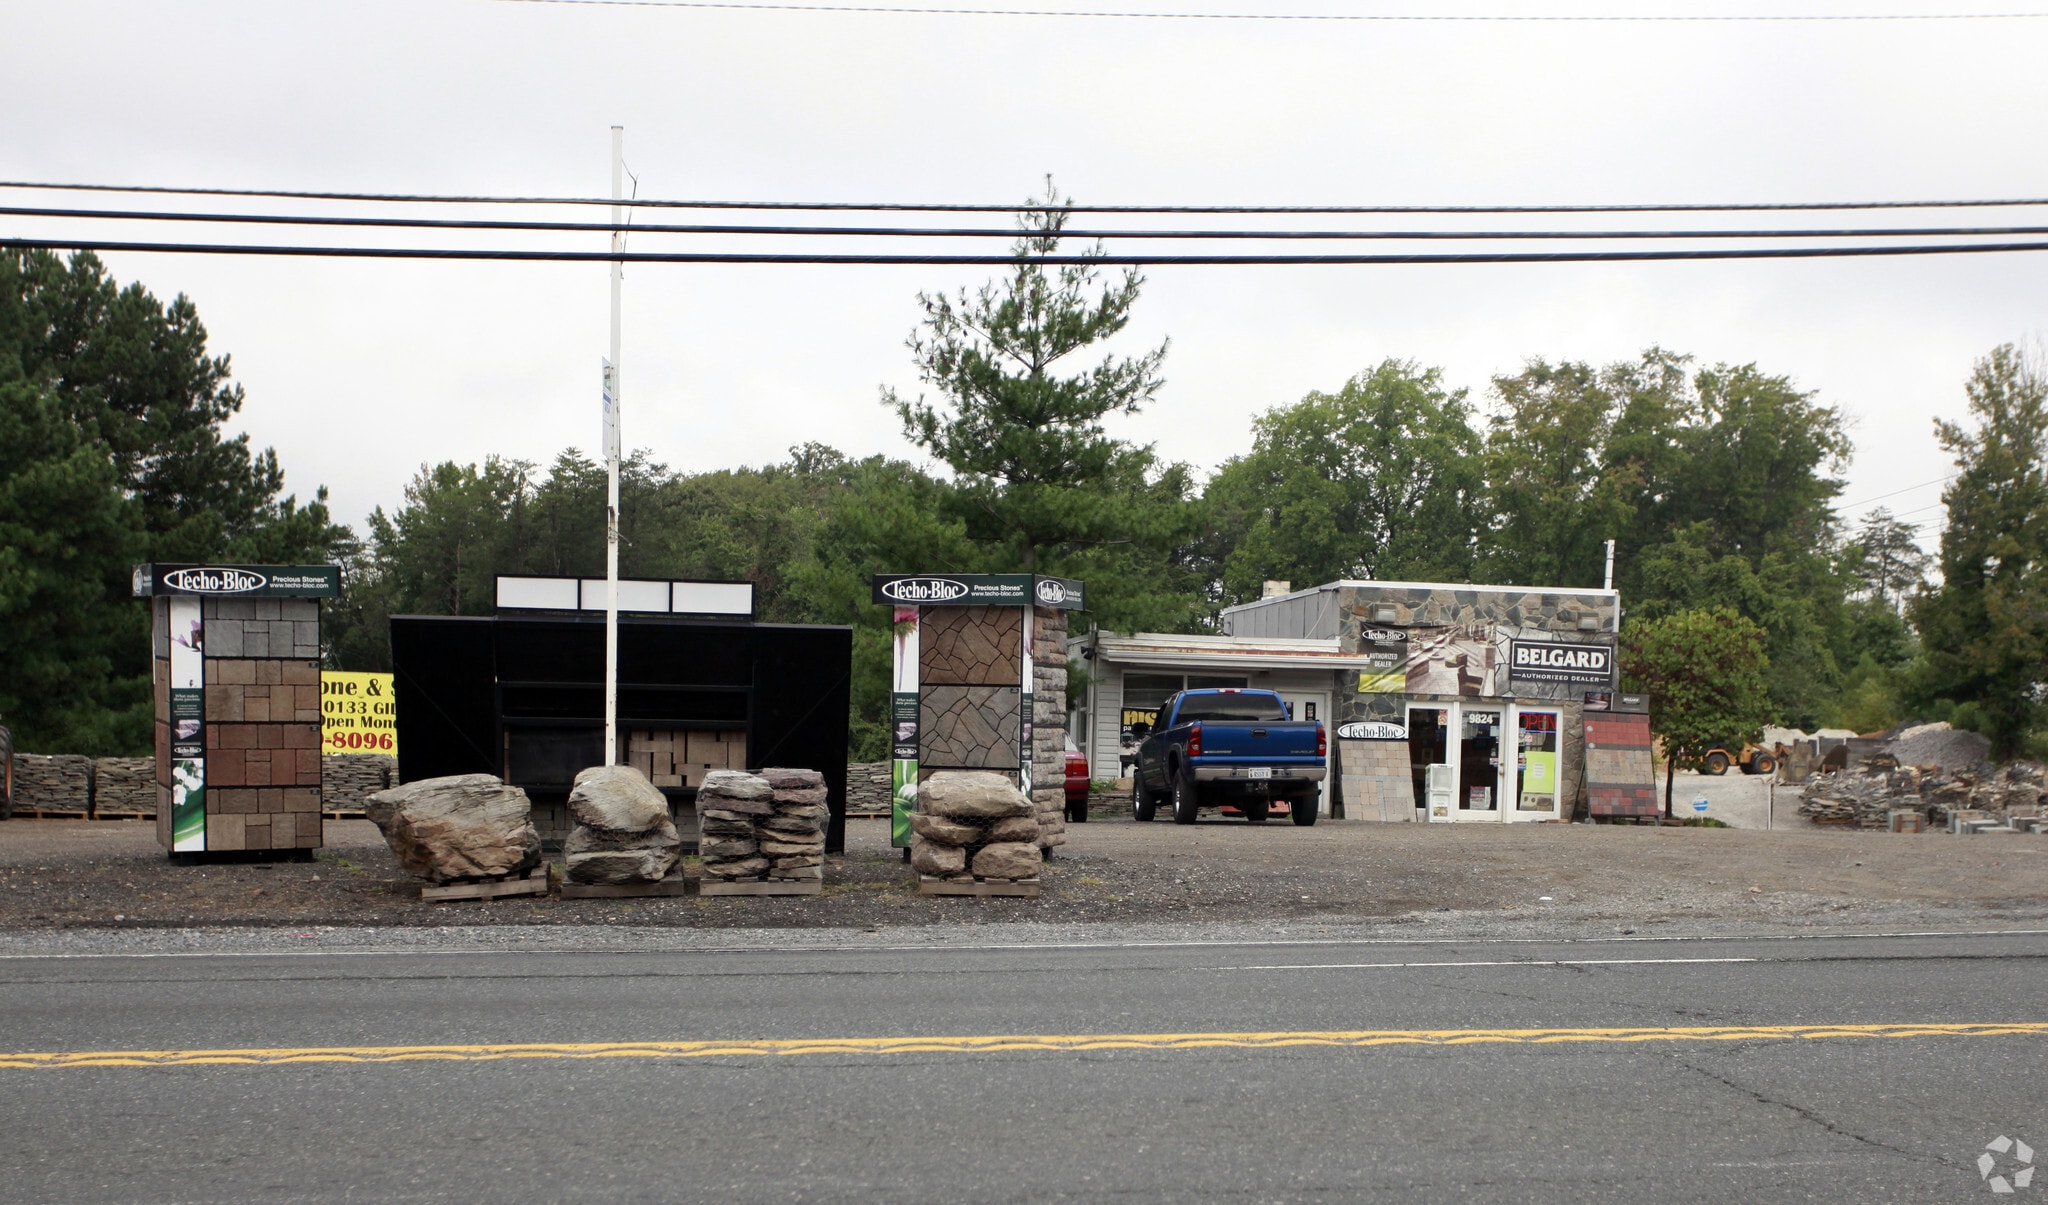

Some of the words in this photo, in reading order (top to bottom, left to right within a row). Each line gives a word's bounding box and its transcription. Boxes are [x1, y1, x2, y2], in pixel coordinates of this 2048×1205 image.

[174, 570, 256, 590] Techo-Bloc
[890, 580, 959, 599] Techo-Bloc
[1368, 630, 1402, 640] Techo-Bloc
[1516, 648, 1605, 668] BELGARD
[1521, 673, 1569, 681] AUTHORIZED
[366, 678, 382, 696] &
[1469, 713, 1494, 724] 9824
[1519, 714, 1556, 730] OPEN
[1346, 725, 1399, 738] Techo-Bloc
[321, 731, 393, 750] -8096
